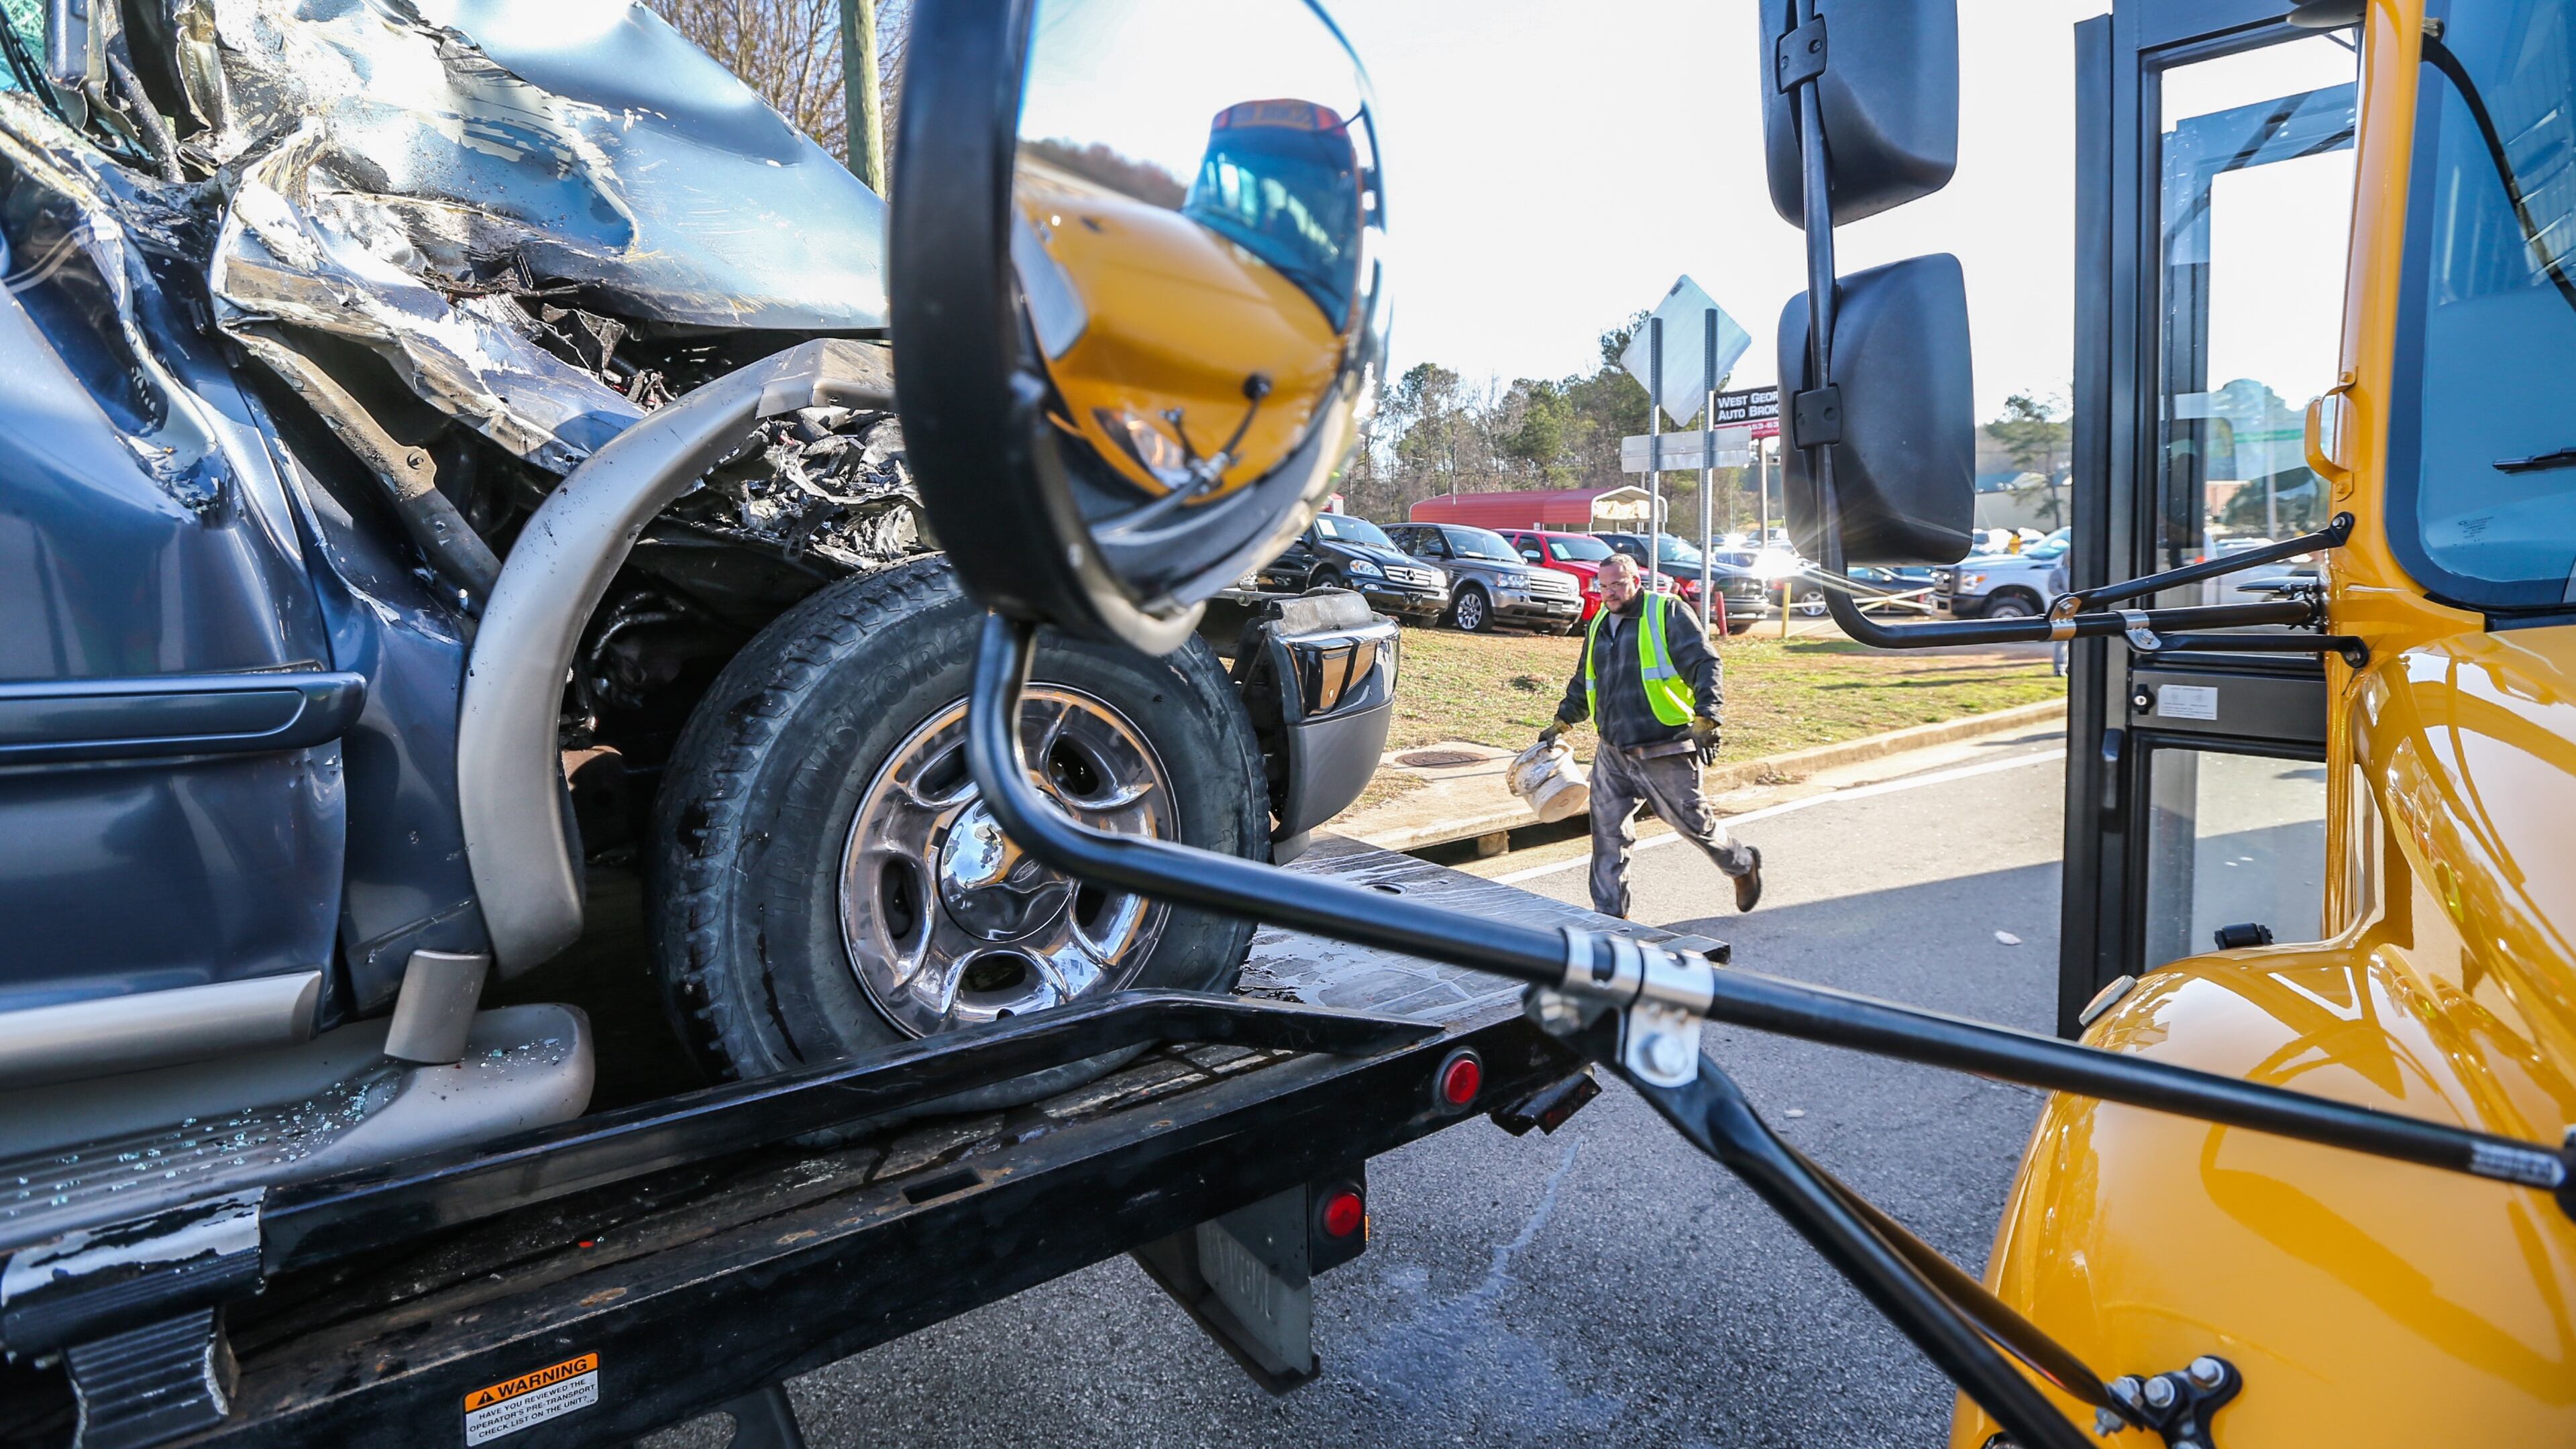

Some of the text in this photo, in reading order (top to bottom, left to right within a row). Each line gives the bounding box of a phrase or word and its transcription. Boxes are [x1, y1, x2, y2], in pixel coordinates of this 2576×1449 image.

[1717, 391, 1778, 409] WEST GEOR
[1717, 404, 1779, 421] AUTO BROK
[762, 624, 973, 918] TRANSFORC
[498, 1358, 587, 1397] WARNING
[470, 1385, 595, 1432] OPERATOR'S PRE-TRANSPORT
[478, 1422, 508, 1438] CHECK
[511, 1416, 529, 1427] LIST
[531, 1411, 543, 1419] ON
[547, 1405, 561, 1414] THE
[564, 1395, 587, 1407] UNIT?
[479, 1379, 586, 1420] HAVE YOU REVIEWED THE
